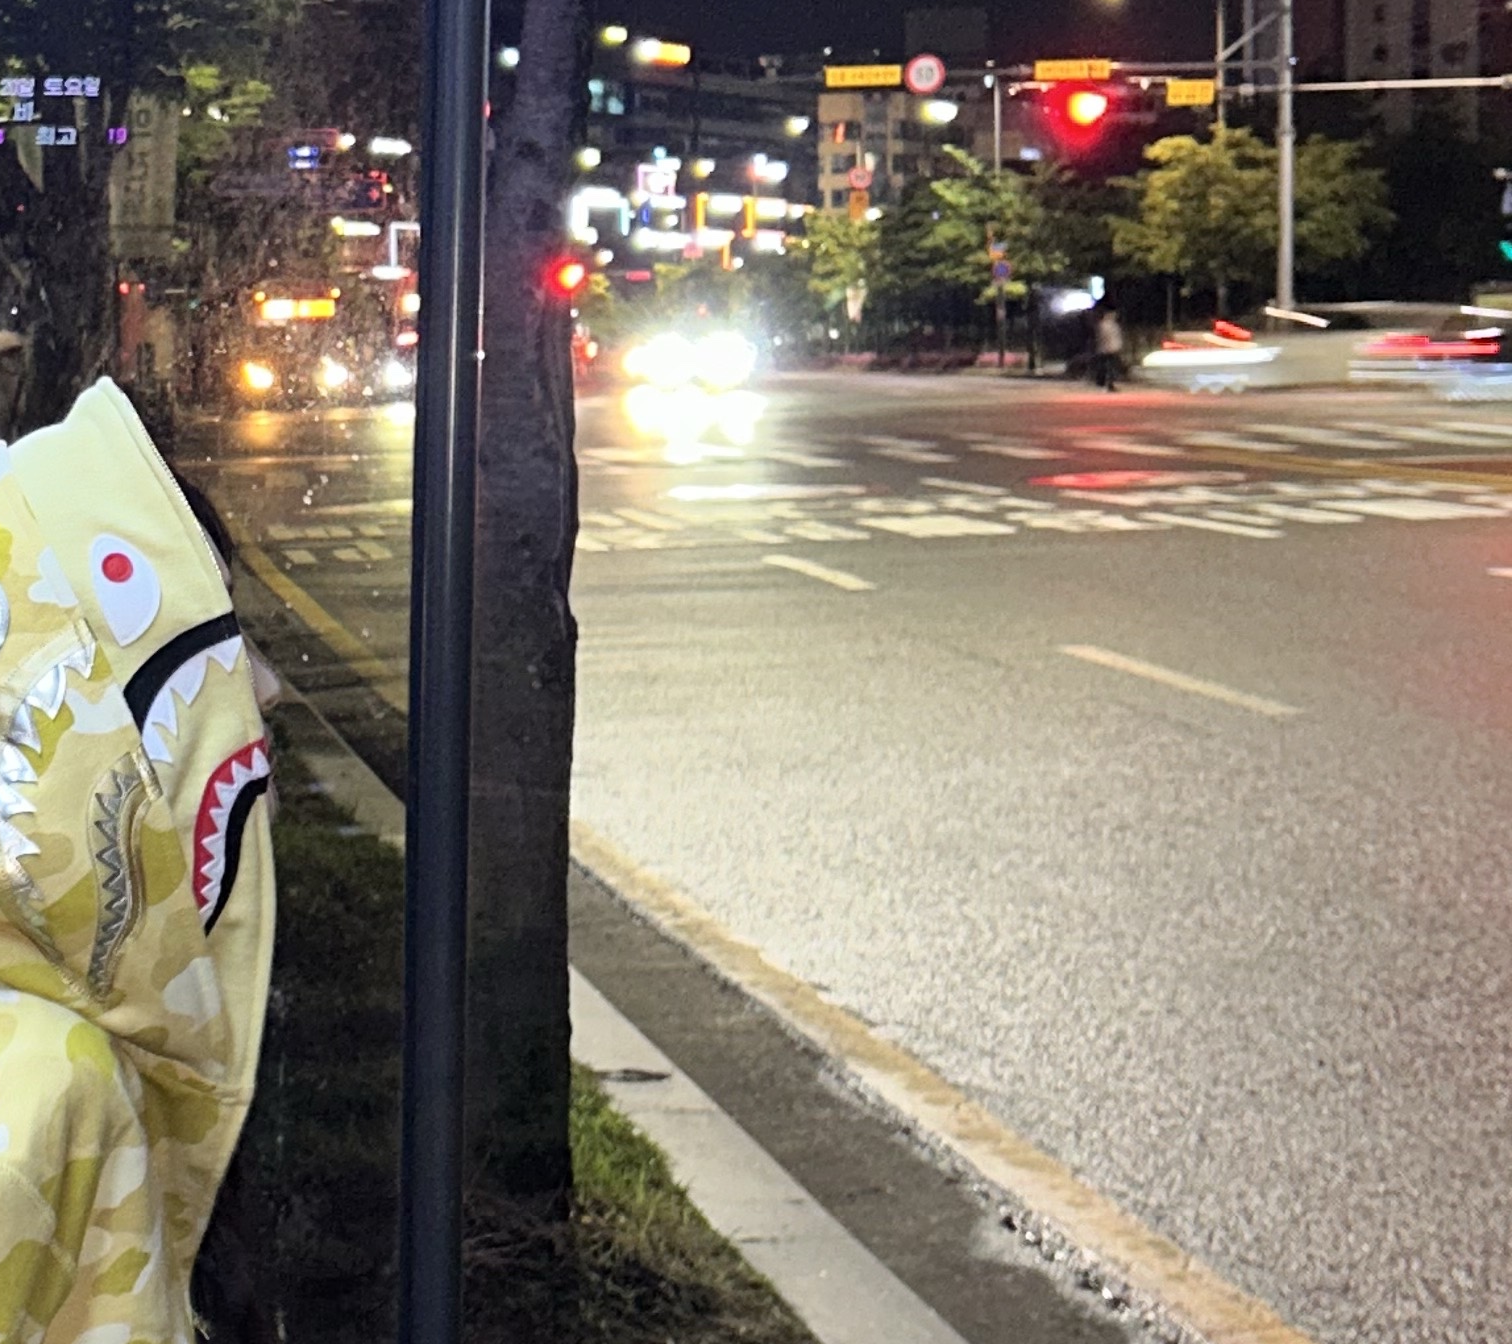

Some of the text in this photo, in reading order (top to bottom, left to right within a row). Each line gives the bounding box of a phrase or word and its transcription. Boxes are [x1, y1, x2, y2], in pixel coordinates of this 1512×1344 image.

[43, 76, 101, 97] 토요일
[35, 126, 77, 146] 최고
[108, 127, 128, 144] 19
